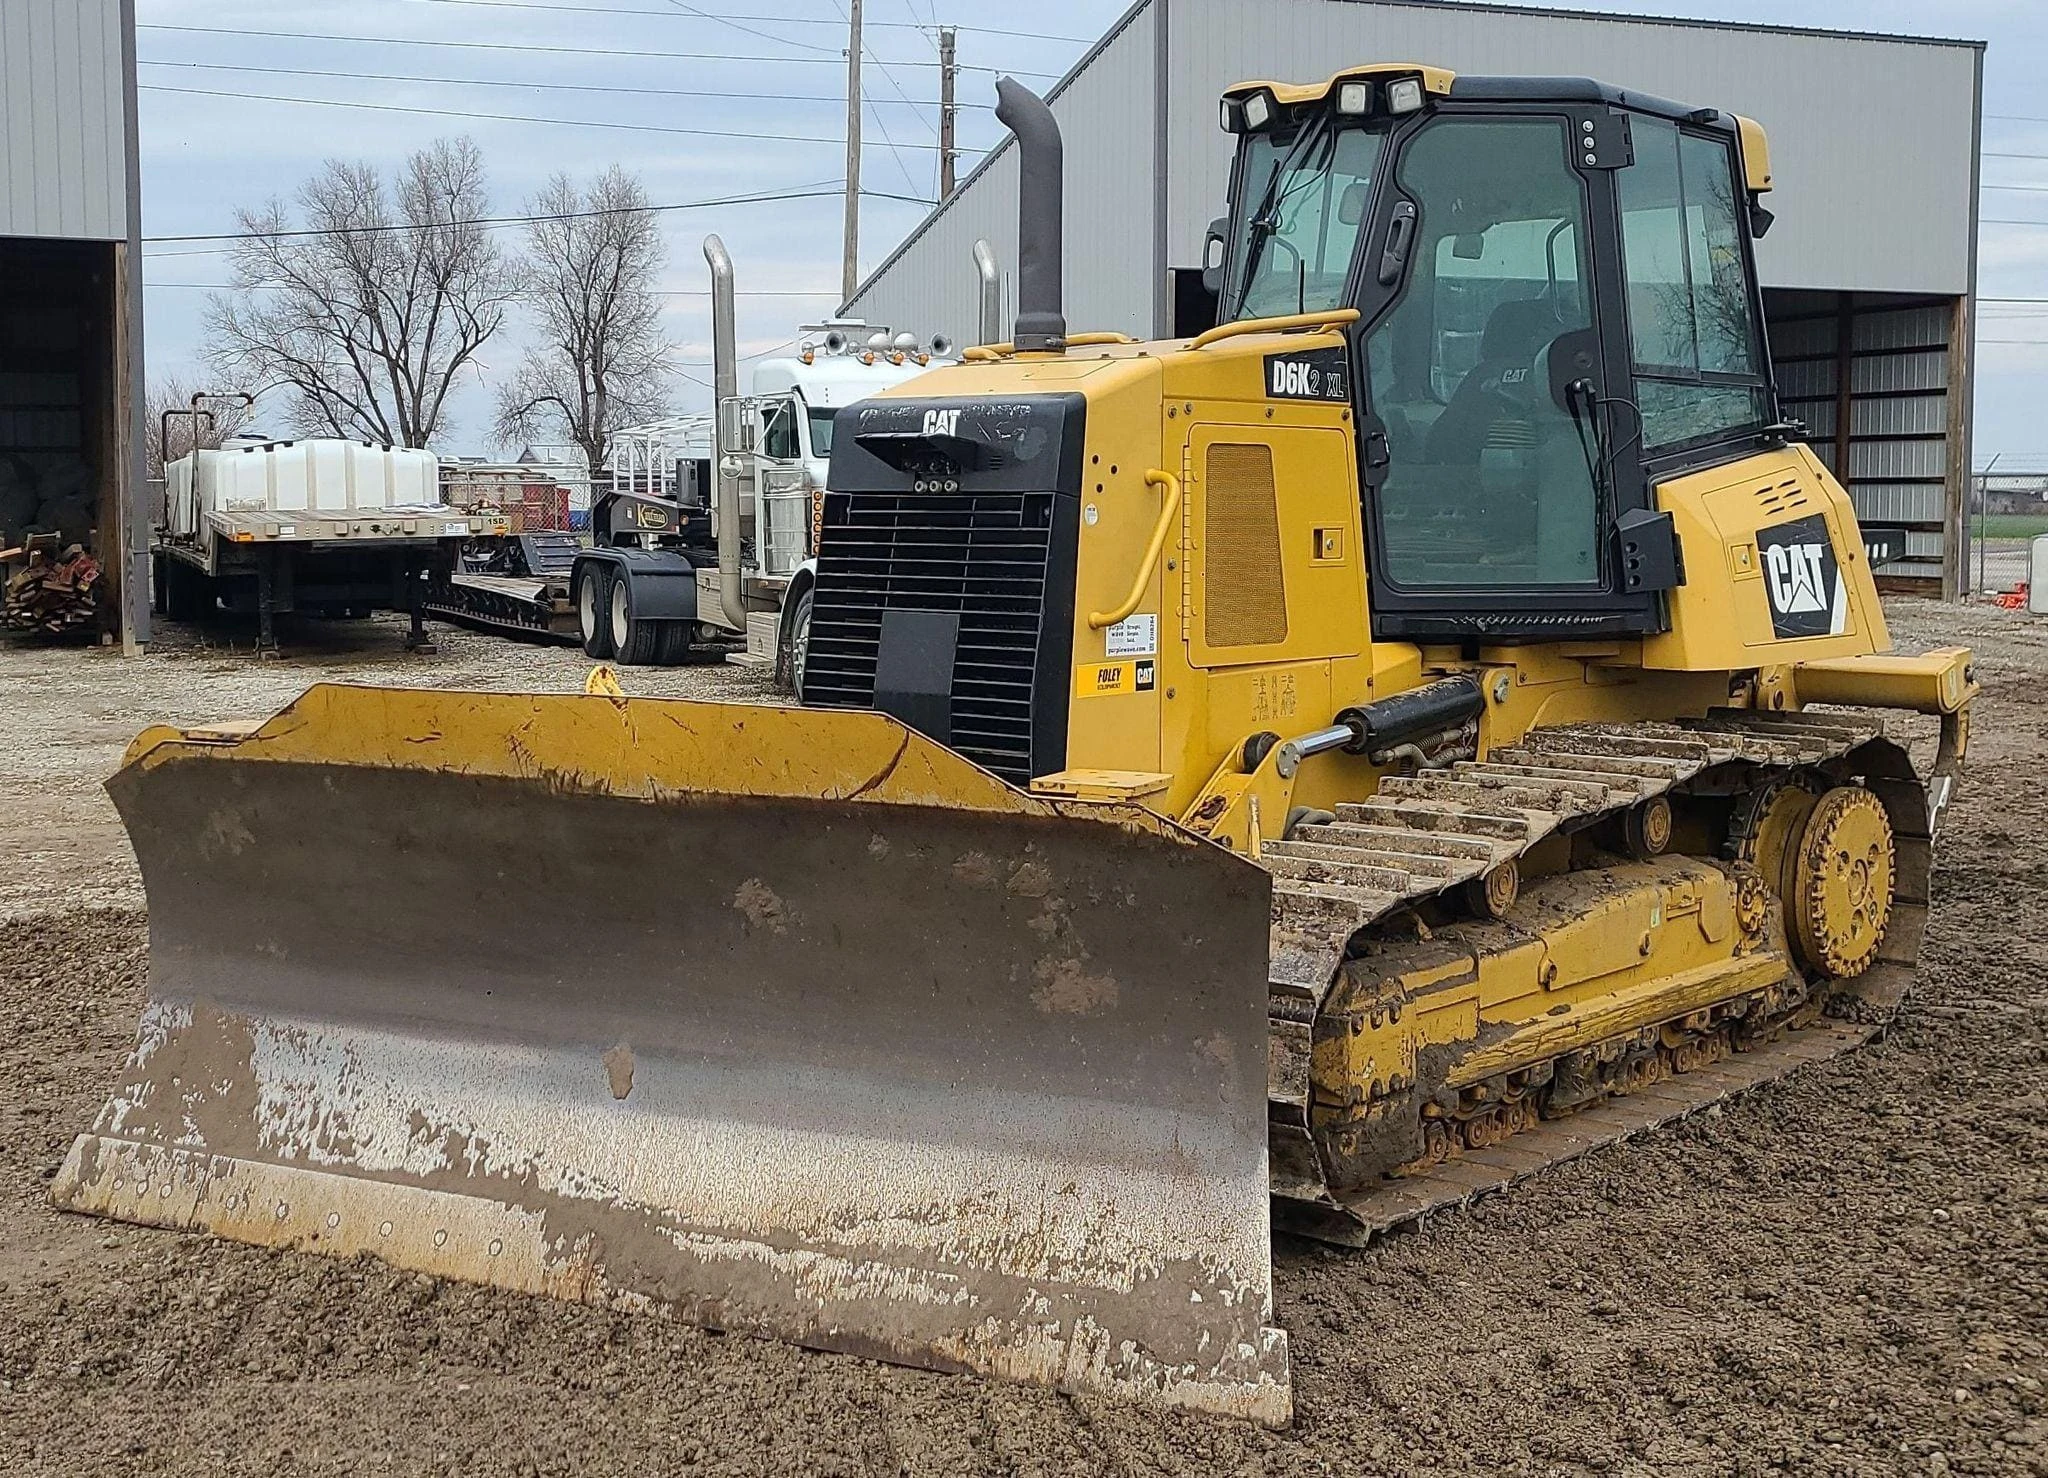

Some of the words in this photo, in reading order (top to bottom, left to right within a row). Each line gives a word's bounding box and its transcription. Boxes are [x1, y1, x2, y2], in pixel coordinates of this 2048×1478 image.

[1326, 372, 1344, 397] XL
[1502, 368, 1528, 382] CAT
[922, 409, 961, 437] CAT
[1767, 543, 1828, 614] CAT
[1097, 667, 1122, 683] FOLEY
[1137, 667, 1154, 684] CAT
